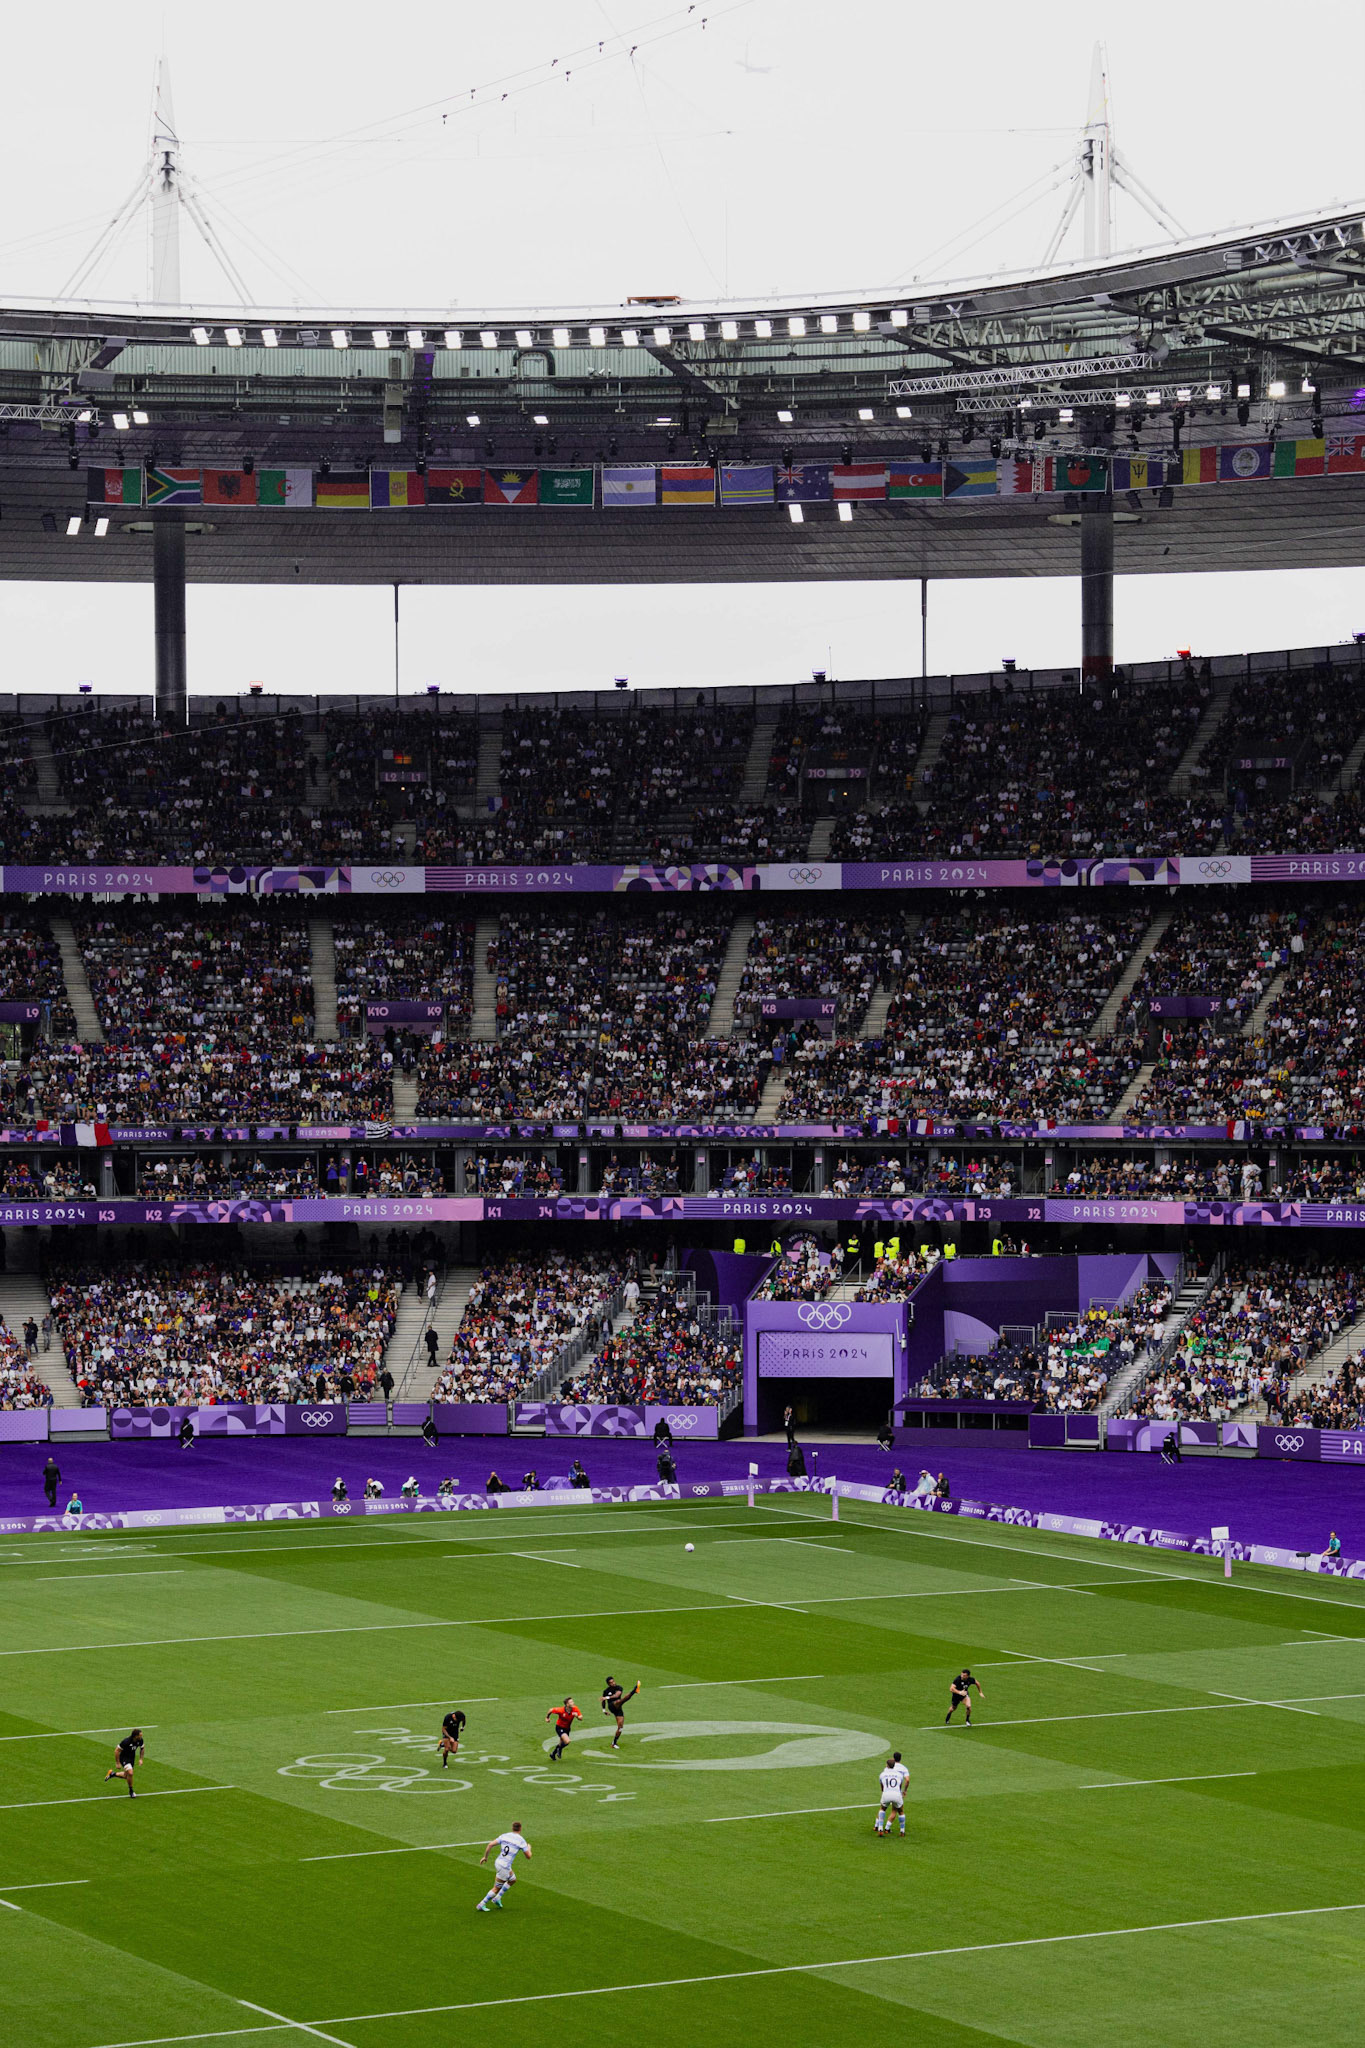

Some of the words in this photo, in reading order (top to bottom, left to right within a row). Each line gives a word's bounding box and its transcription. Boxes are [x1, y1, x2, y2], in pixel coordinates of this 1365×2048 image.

[1240, 759, 1252, 769] J8
[1275, 758, 1286, 768] J7
[385, 772, 397, 782] L2
[411, 772, 421, 782] L1
[807, 768, 826, 778] J10
[849, 768, 861, 778] J9
[105, 873, 153, 886] 2024
[525, 872, 573, 885] 2024
[940, 868, 987, 881] 2024
[367, 1006, 389, 1017] K10
[427, 1006, 442, 1016] K9
[762, 1004, 777, 1014] K8
[821, 1004, 835, 1014] K7
[1150, 1002, 1161, 1012] J6
[1210, 1001, 1221, 1012] J5
[26, 1007, 39, 1018] L9
[45, 1208, 86, 1220] 2024
[393, 1205, 433, 1215] 2024
[487, 1206, 502, 1218] K1
[538, 1206, 553, 1218] J4
[772, 1203, 812, 1214] 2024
[978, 1207, 992, 1219] J3
[1027, 1207, 1041, 1220] J2
[1120, 1206, 1157, 1217] 2024
[98, 1210, 116, 1222] K3
[145, 1209, 163, 1221] K2
[829, 1348, 867, 1359] 2024
[885, 1778, 898, 1788] 10
[501, 1845, 510, 1857] 9
